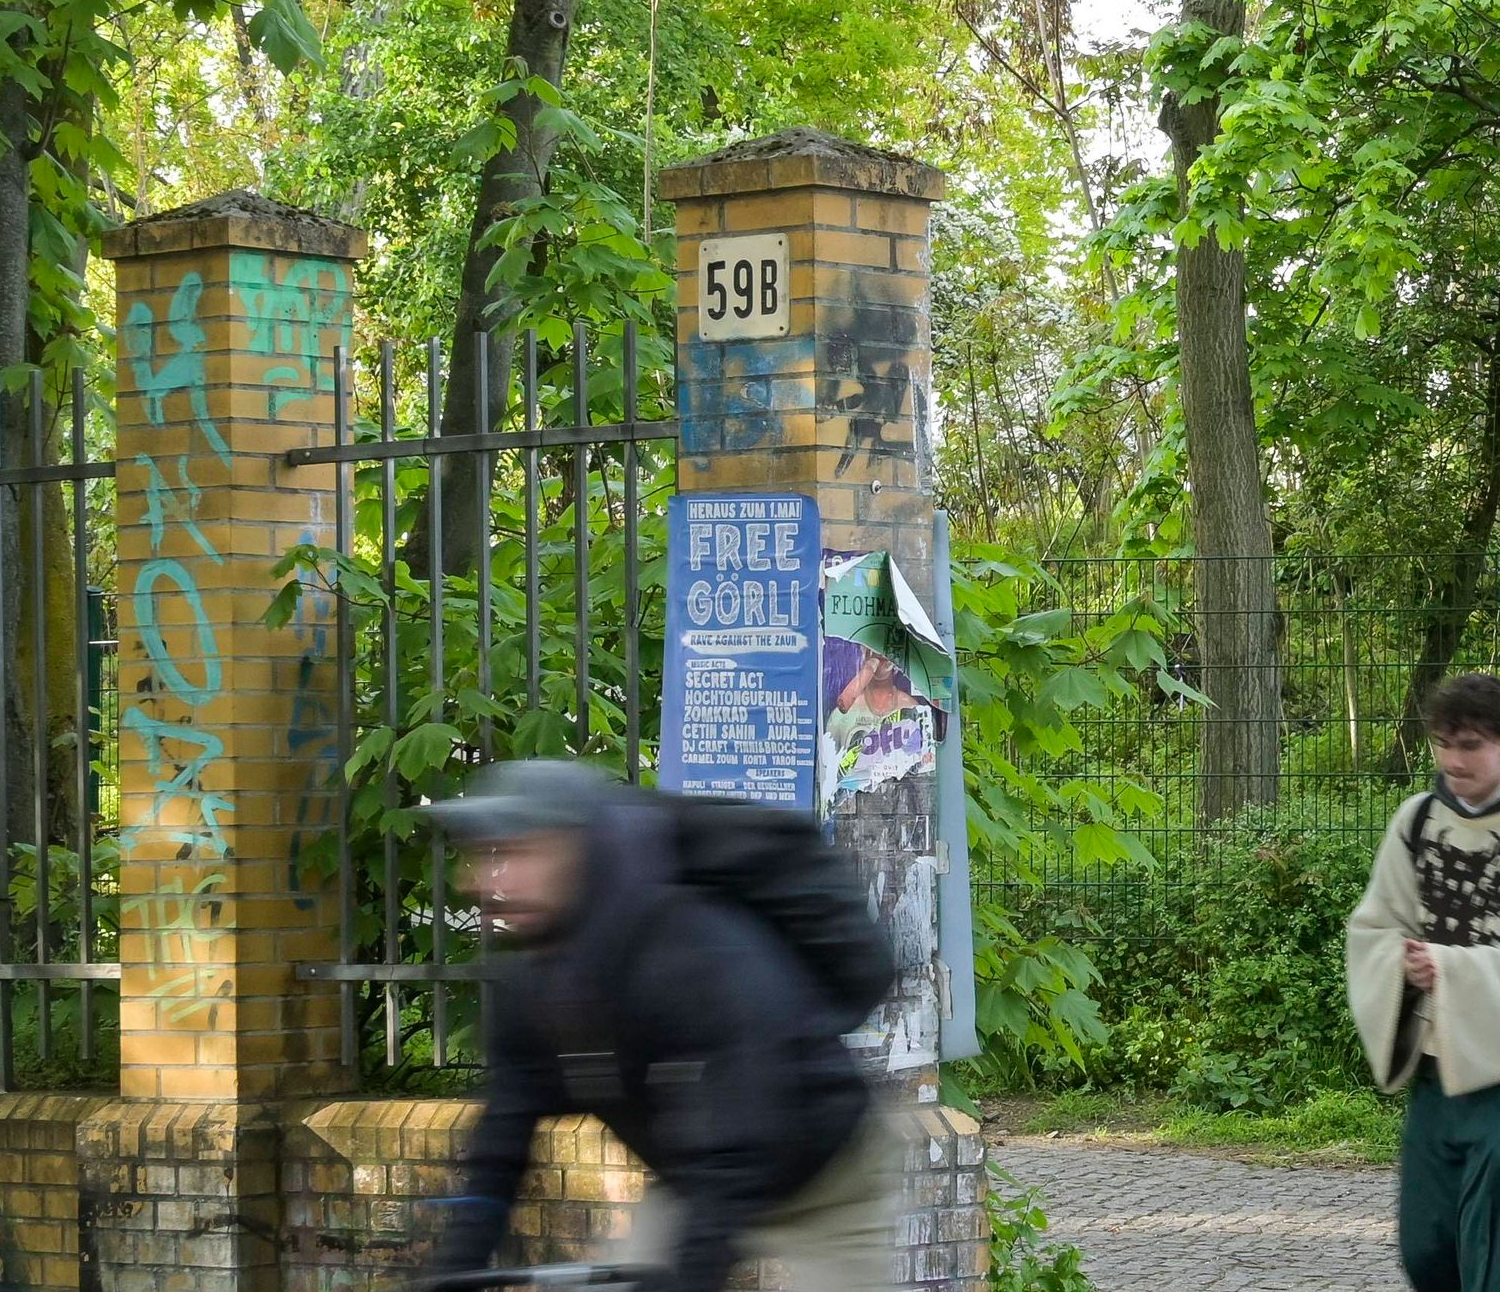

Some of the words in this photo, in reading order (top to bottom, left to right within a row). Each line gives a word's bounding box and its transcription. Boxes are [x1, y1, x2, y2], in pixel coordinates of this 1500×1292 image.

[706, 258, 779, 321] 59B
[690, 503, 736, 519] HERAUS
[739, 502, 766, 518] ZUM
[769, 502, 800, 518] 1.MAI
[689, 523, 801, 571] FREE
[687, 572, 800, 626] GÖRLI
[690, 634, 713, 646] RAVE
[715, 634, 753, 647] AGAINST
[755, 634, 772, 646] THE
[775, 635, 797, 647] ZAUN
[685, 672, 736, 689] SECRET
[739, 672, 764, 689] ACT
[685, 690, 798, 707] HOCHTONGUERILLA
[766, 707, 797, 724] RUBI
[682, 724, 717, 739] CETIN
[721, 725, 756, 739] SAHIN
[767, 725, 798, 740] AURA
[682, 741, 696, 753] DJ
[698, 741, 729, 753] CRAFT
